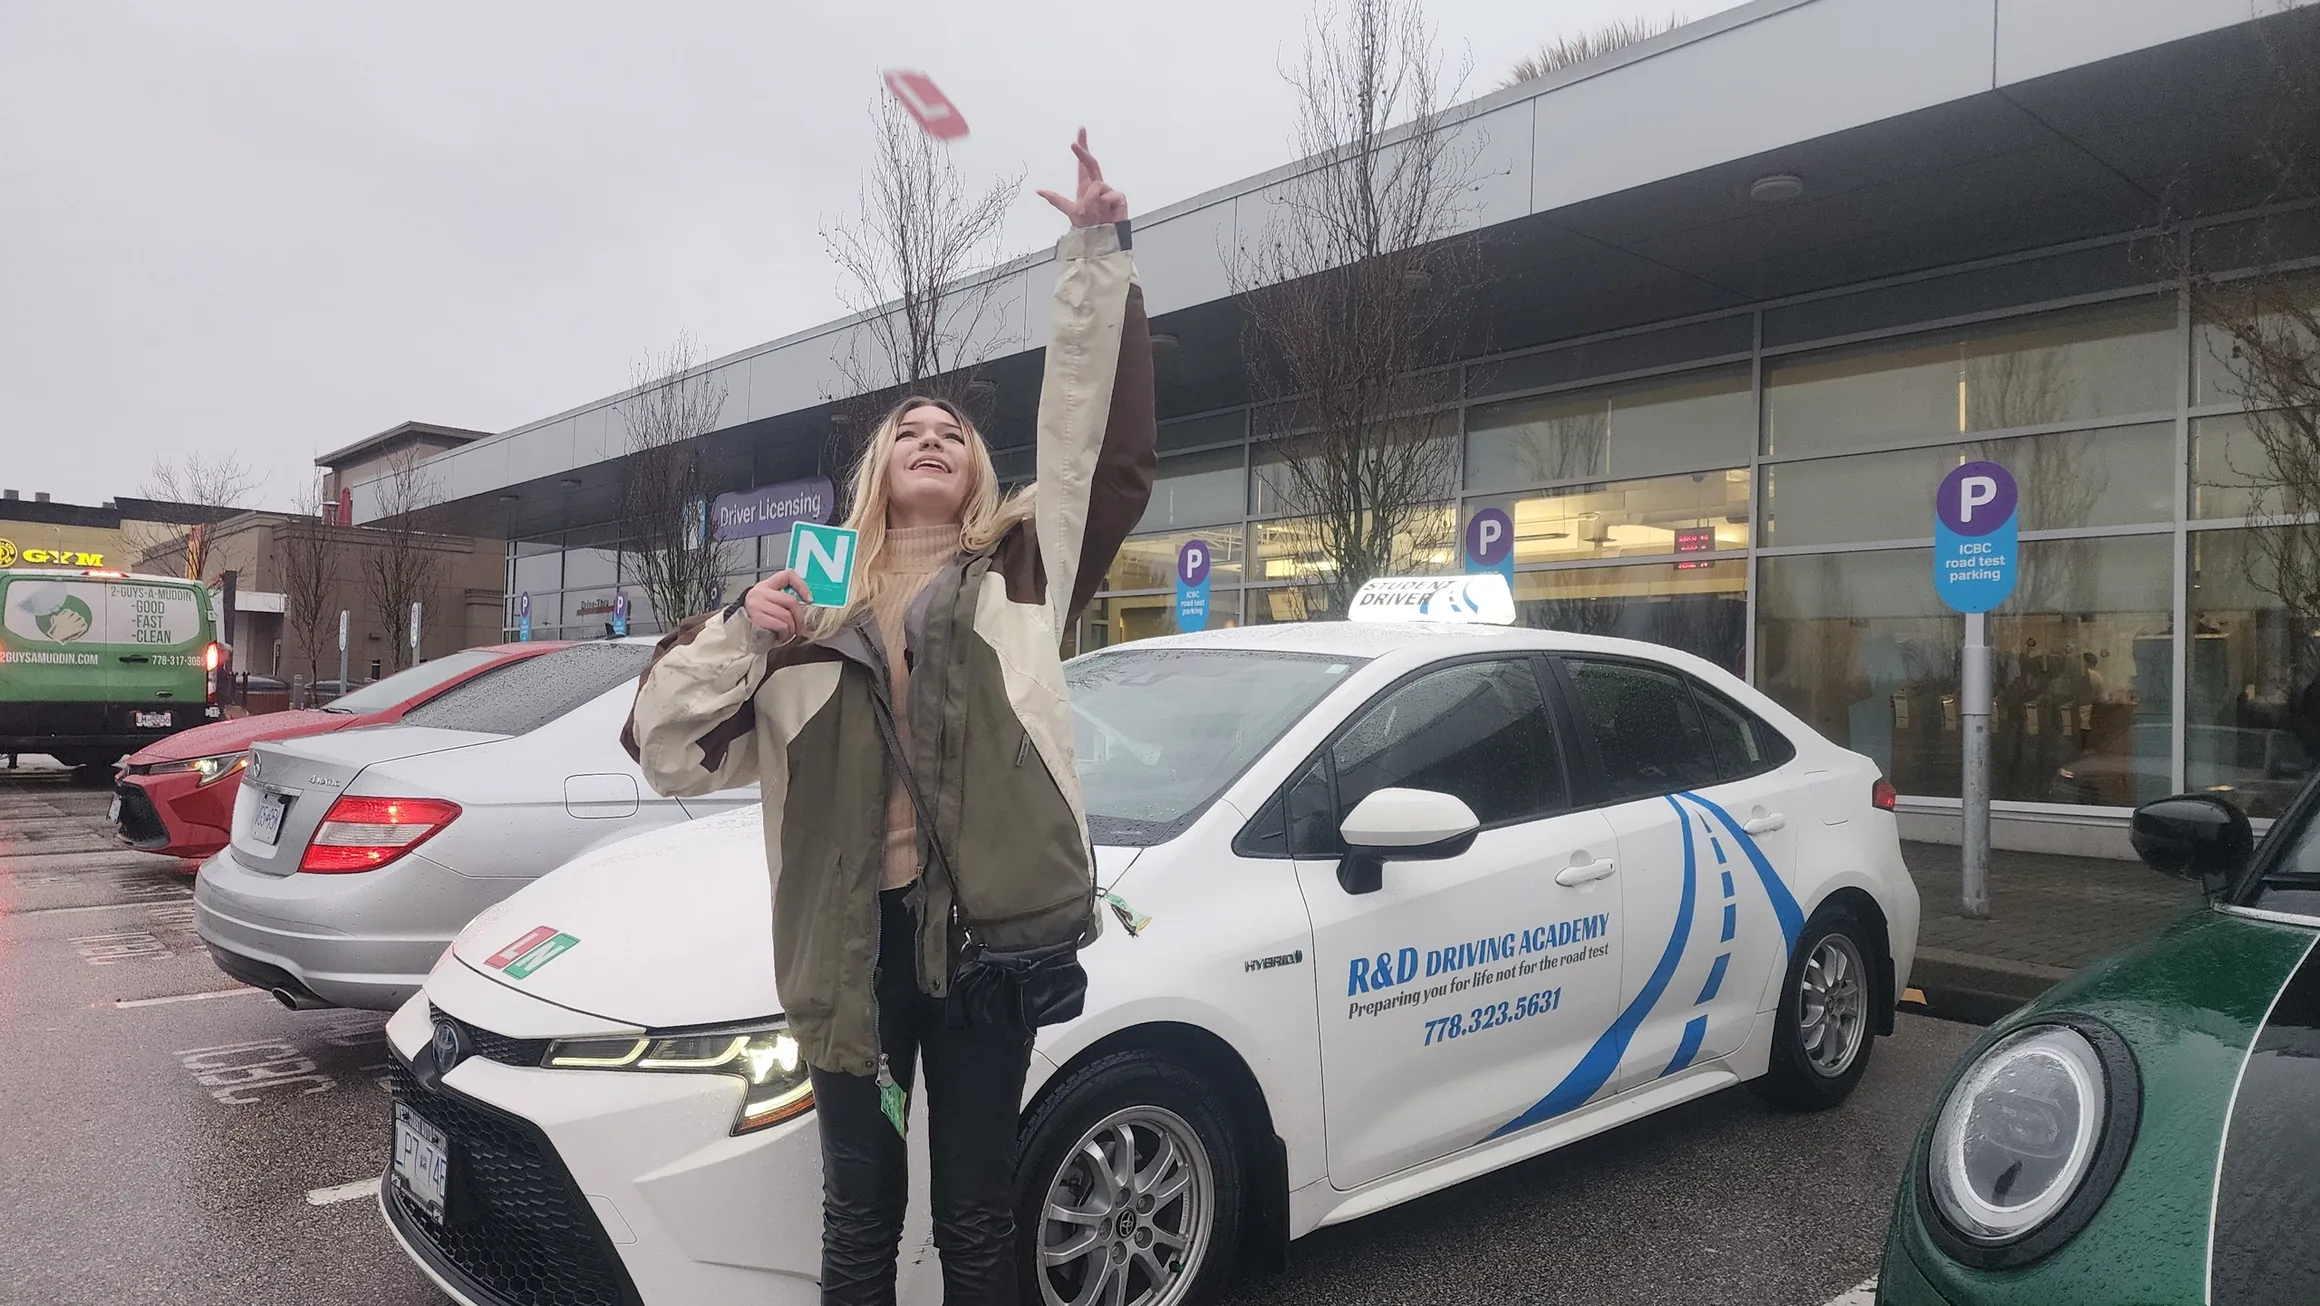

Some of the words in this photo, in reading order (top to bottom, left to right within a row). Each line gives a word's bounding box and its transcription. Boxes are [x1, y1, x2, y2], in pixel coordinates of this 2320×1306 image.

[892, 73, 951, 121] L
[720, 503, 757, 527] Driver
[759, 491, 821, 521] Licensing
[1960, 476, 1997, 523] P
[1480, 520, 1502, 556] P
[23, 549, 104, 567] GYM
[795, 530, 850, 583] N
[1959, 543, 1992, 555] ICBC
[1187, 549, 1203, 579] P
[1946, 558, 1976, 569] road
[1979, 556, 2006, 568] test
[1363, 581, 1460, 591] STUDENT
[1950, 569, 2001, 584] parking
[111, 586, 192, 602] 2-GUYS-A-MUDDIN
[522, 596, 529, 613] P
[1359, 593, 1435, 606] DRIVER
[616, 596, 624, 615] P
[1182, 608, 1203, 616] parking
[0, 651, 98, 665] 2GUYSAMUDDIN.COM
[499, 932, 540, 961] L
[515, 940, 566, 972] N
[1347, 947, 1419, 997] R&D
[1425, 935, 1515, 978] DRIVING
[1518, 912, 1610, 956] ACADEMY
[1244, 952, 1296, 973] HYBRID
[1348, 990, 1421, 1020] Preparing
[1422, 985, 1447, 1005] you
[1449, 976, 1471, 994] for
[1472, 967, 1493, 988] life
[1496, 965, 1516, 982] not
[1519, 960, 1538, 978] for
[1539, 953, 1558, 972] the
[1560, 947, 1587, 966] road
[1588, 942, 1609, 959] test
[1424, 986, 1562, 1047] 778.323.5631
